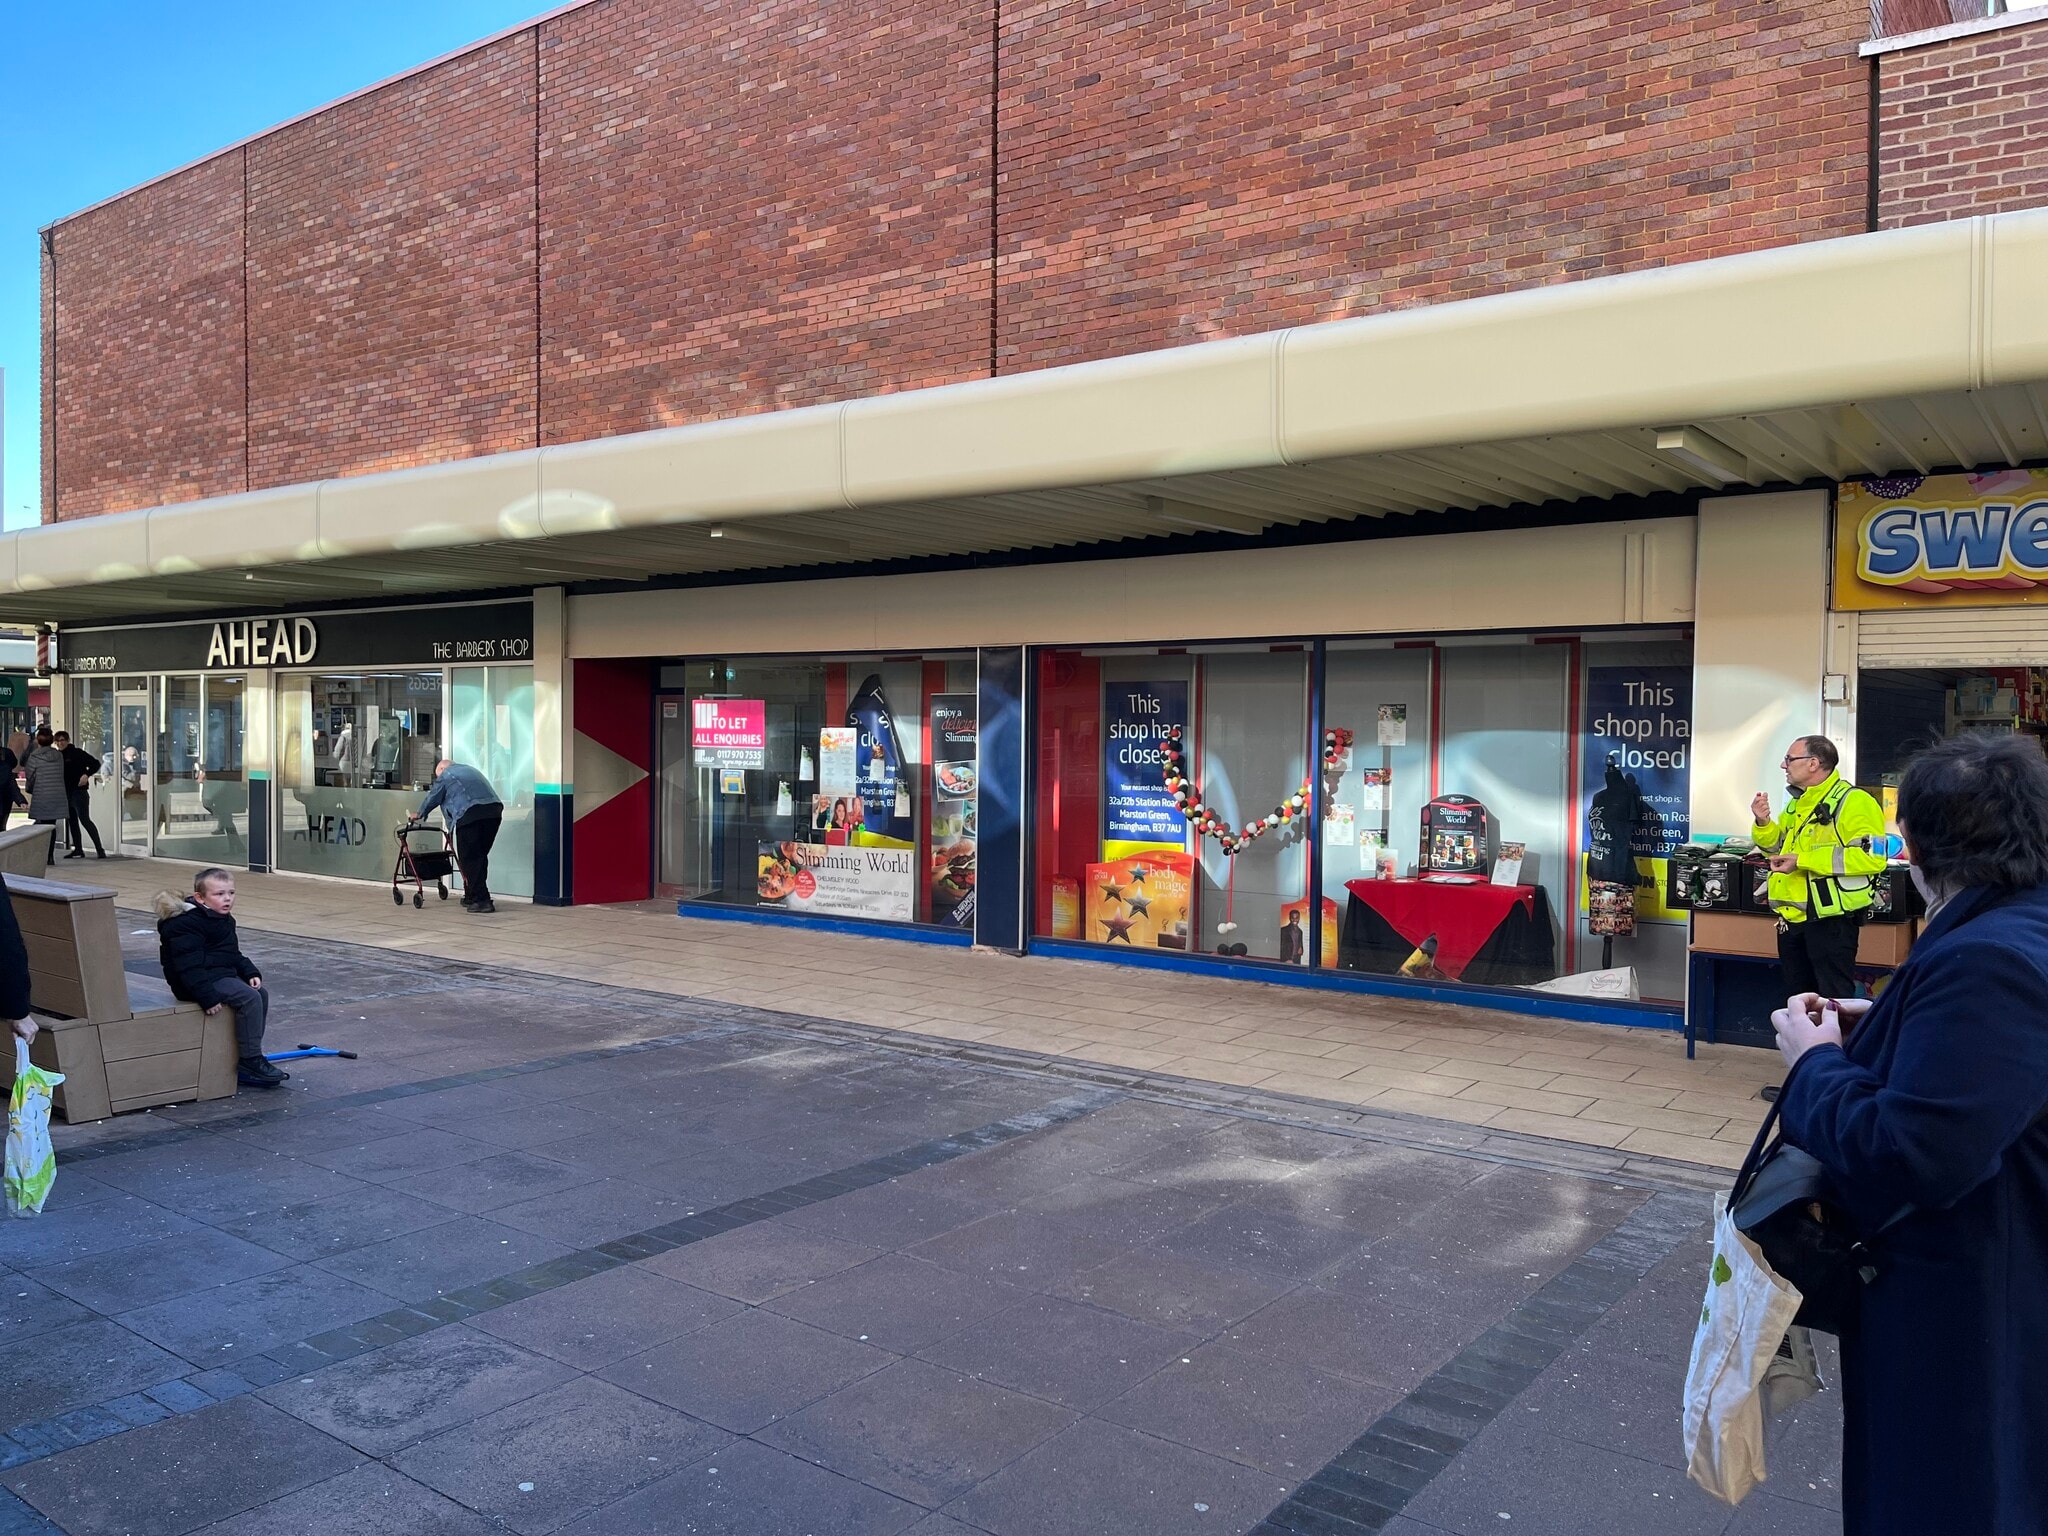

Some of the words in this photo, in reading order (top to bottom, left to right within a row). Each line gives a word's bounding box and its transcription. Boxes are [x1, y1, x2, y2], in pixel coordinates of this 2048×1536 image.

[207, 617, 317, 666] AHEAD
[433, 642, 452, 659] THE
[456, 640, 495, 658] BARBERS
[500, 638, 529, 656] SHOP
[60, 658, 73, 671] THE
[99, 656, 117, 670] SHOP
[1622, 681, 1675, 707] This
[1128, 694, 1161, 714] This
[936, 708, 956, 719] enjoy
[712, 717, 726, 729] TO
[728, 717, 747, 729] LET
[1593, 712, 1653, 743] shop
[1109, 718, 1149, 743] shop
[696, 733, 712, 744] ALL
[713, 733, 762, 745] ENQUIRIES
[717, 750, 730, 759] 0117
[731, 750, 744, 760] 970
[745, 751, 762, 760] 7535
[1150, 784, 1163, 792] shop
[1108, 796, 1135, 806] 32a/32b
[1135, 797, 1161, 807] Station
[1161, 798, 1177, 808] Roa
[1654, 795, 1673, 804] shop
[1119, 809, 1147, 819] Marston
[1147, 810, 1171, 821] Green,
[1439, 807, 1473, 818] Slimming
[1641, 811, 1669, 822] ation
[1671, 811, 1690, 823] Roa
[1445, 815, 1467, 824] World
[1109, 821, 1152, 833] Birmingham,
[1152, 822, 1167, 833] B37
[1166, 823, 1182, 833] 7AU
[1650, 826, 1684, 840] Green,
[1656, 842, 1676, 853] B37
[796, 846, 862, 875] Slimming
[866, 852, 909, 874] World
[1149, 864, 1177, 879] body
[1155, 880, 1188, 893] magic
